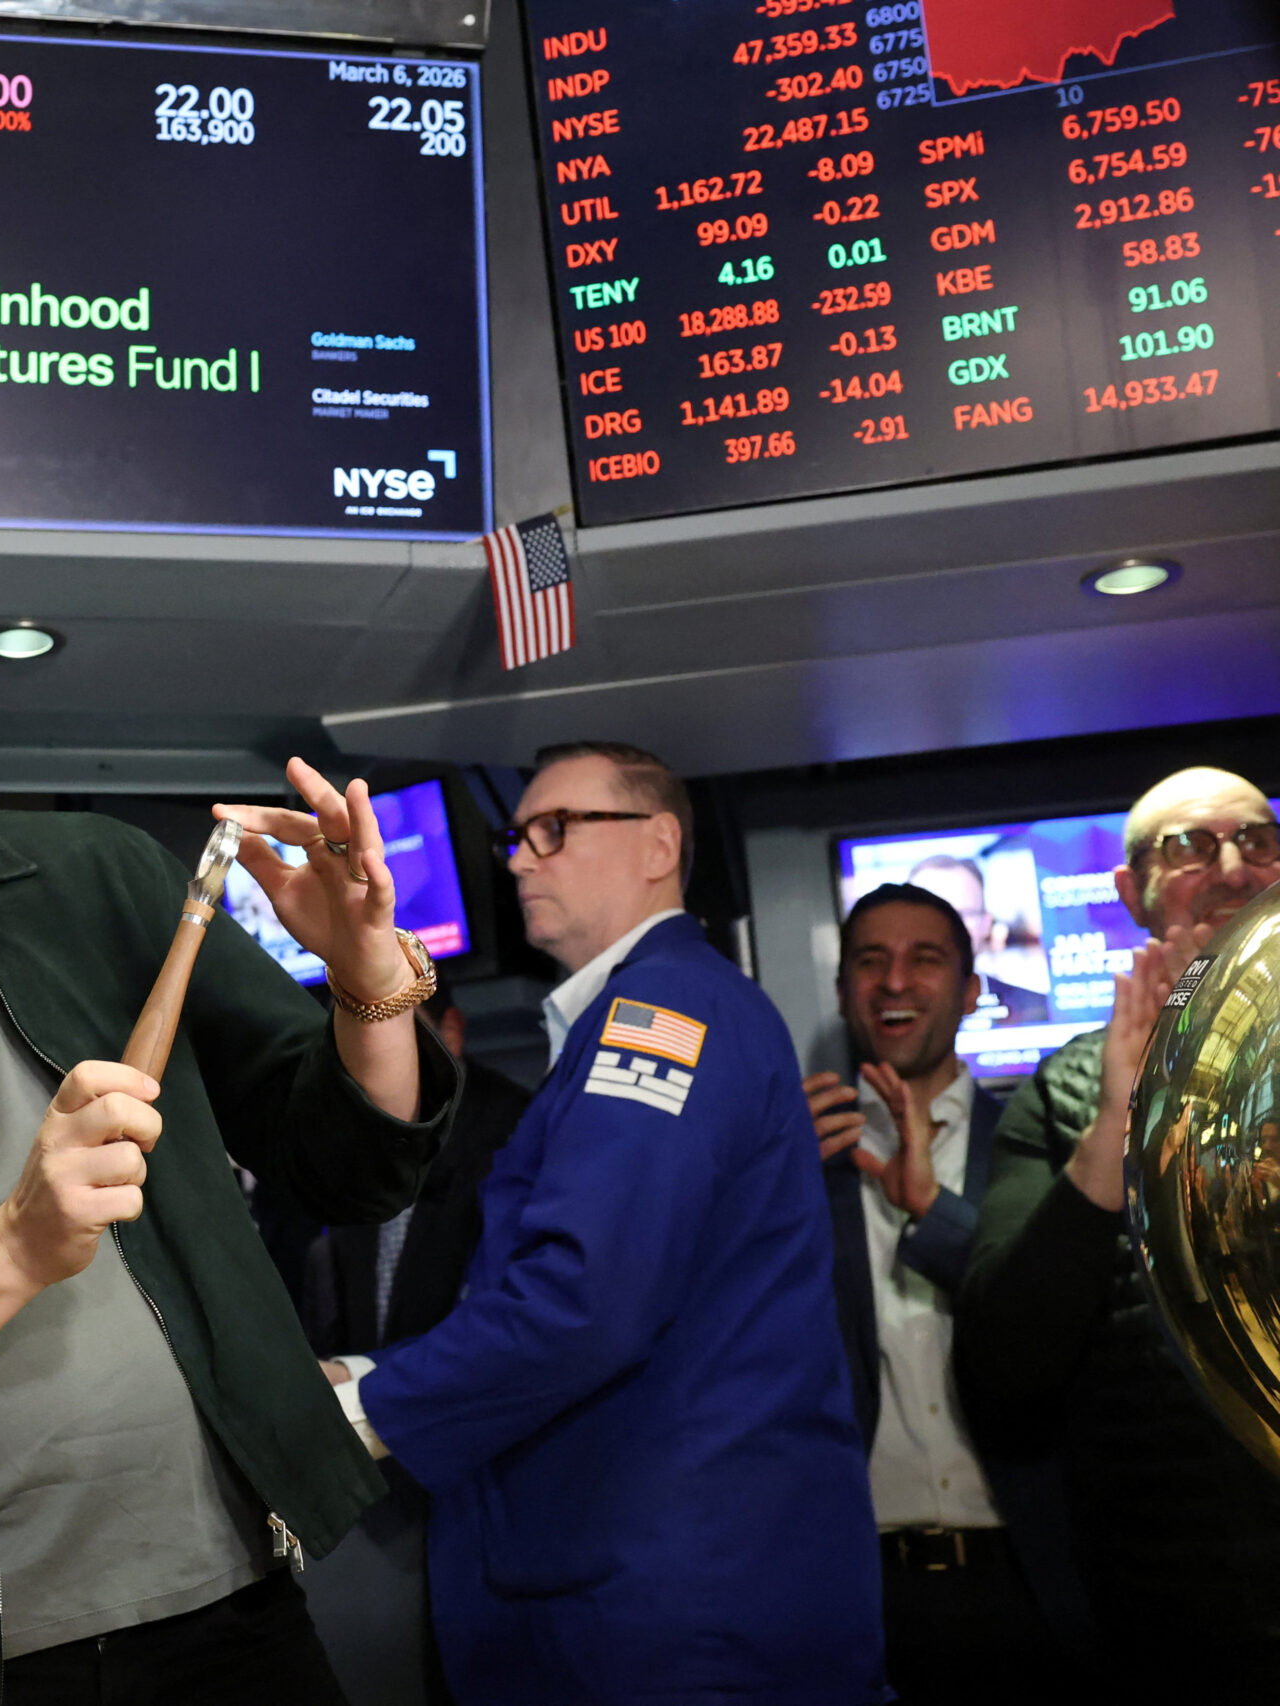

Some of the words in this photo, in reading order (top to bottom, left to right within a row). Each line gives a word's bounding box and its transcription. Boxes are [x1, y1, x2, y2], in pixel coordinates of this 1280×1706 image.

[866, 0, 920, 28] 6800
[543, 27, 607, 60] INDU
[733, 22, 858, 65] 47,359.33
[869, 27, 924, 55] 6775
[329, 60, 388, 84] March
[393, 65, 412, 87] 6,
[417, 65, 466, 88] 2026
[547, 69, 610, 102] INDP
[765, 65, 863, 102] -302.40
[873, 56, 928, 83] 6750
[154, 83, 254, 121] 22.00
[367, 96, 466, 133] 22.05
[876, 82, 931, 110] 6725
[1056, 84, 1084, 108] 10
[155, 117, 255, 145] 163,900
[552, 108, 620, 142] NYSE
[742, 107, 869, 152] 22,487.15
[919, 130, 984, 164] SPMi
[1062, 97, 1181, 140] 6,759.50
[420, 131, 466, 157] 200
[557, 154, 611, 184] NYA
[924, 177, 979, 208] SPX
[1068, 141, 1188, 184] 6,754.59
[561, 196, 619, 226] UTIL
[655, 169, 763, 210] 1,162.72
[808, 150, 874, 182] -8.09
[565, 238, 618, 268] DXY
[697, 212, 769, 246] 99.09
[813, 193, 880, 226] -0.22
[930, 219, 996, 252] GDM
[1074, 186, 1195, 230] 2,912.86
[570, 277, 639, 310] TENY
[717, 255, 775, 286] 4.16
[827, 237, 887, 269] 0.01
[936, 264, 994, 297] KBE
[1123, 232, 1201, 267] 58.83
[574, 326, 604, 354] US
[608, 320, 646, 349] 100
[678, 298, 780, 338] 18,288.88
[810, 281, 892, 315] -232.59
[942, 305, 1018, 342] BRNT
[1128, 277, 1208, 313] 91.06
[311, 331, 374, 349] Goldman
[374, 334, 416, 351] Sachs
[948, 353, 1009, 386] GDX
[1119, 323, 1214, 361] 101.90
[128, 345, 237, 392] Fund
[580, 367, 622, 396] ICE
[697, 342, 783, 379] 163.87
[829, 324, 898, 357] -0.13
[311, 388, 362, 405] Citadel
[362, 390, 430, 408] Securities
[585, 409, 642, 440] DRG
[680, 386, 790, 427] 1,141.89
[819, 369, 904, 404] -14.04
[953, 396, 1033, 431] FANG
[1083, 368, 1219, 413] 14,933.47
[588, 450, 660, 483] ICEBIO
[724, 430, 796, 464] 397.66
[853, 414, 910, 445] -2.91
[1184, 959, 1210, 976] RVI
[1164, 991, 1192, 1007] NYSE
